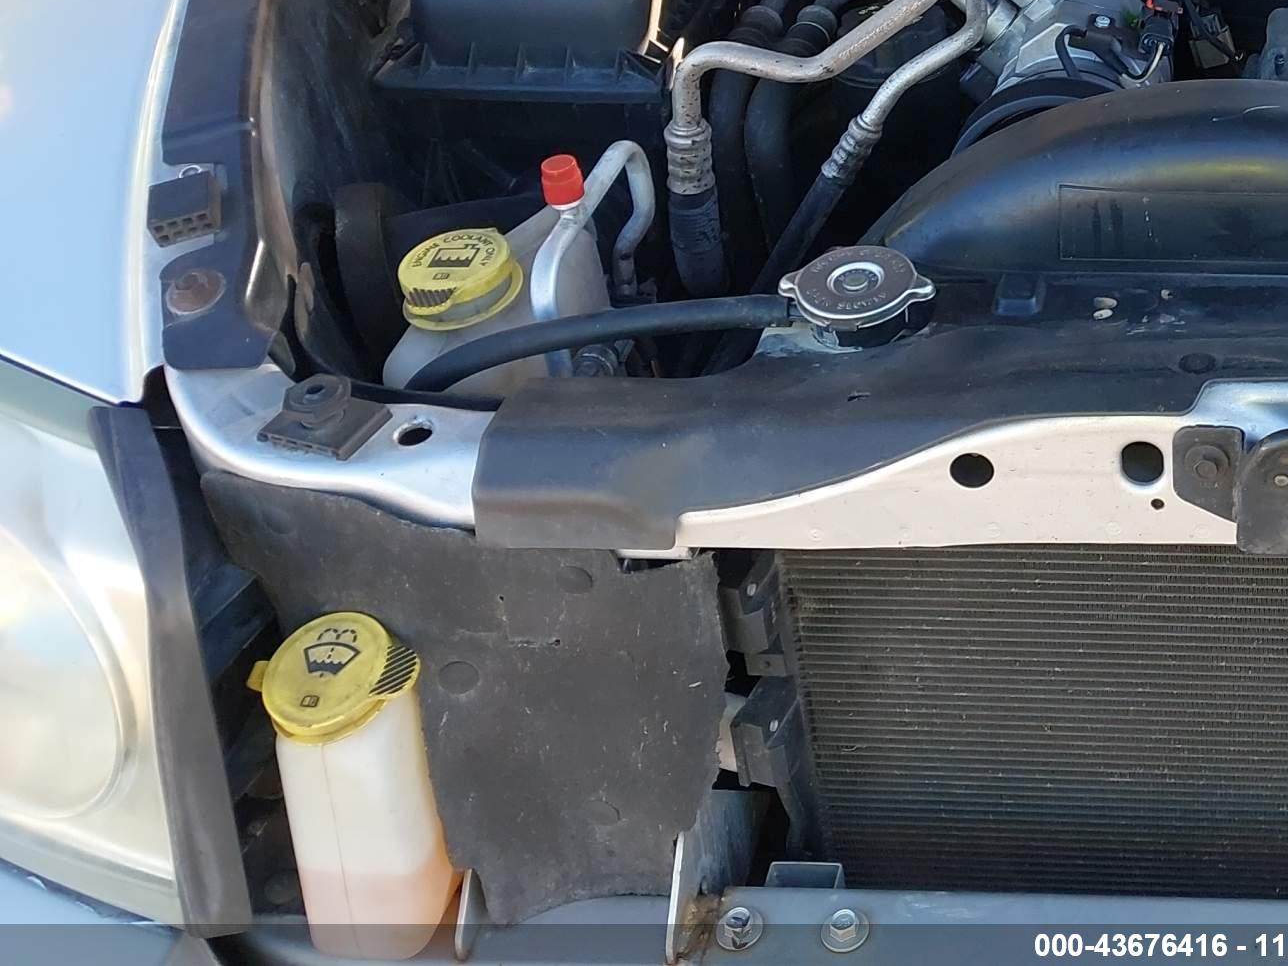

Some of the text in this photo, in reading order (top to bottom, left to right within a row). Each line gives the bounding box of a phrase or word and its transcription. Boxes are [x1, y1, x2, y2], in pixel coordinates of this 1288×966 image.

[412, 233, 496, 267] ENGINE COOLANT ONLY
